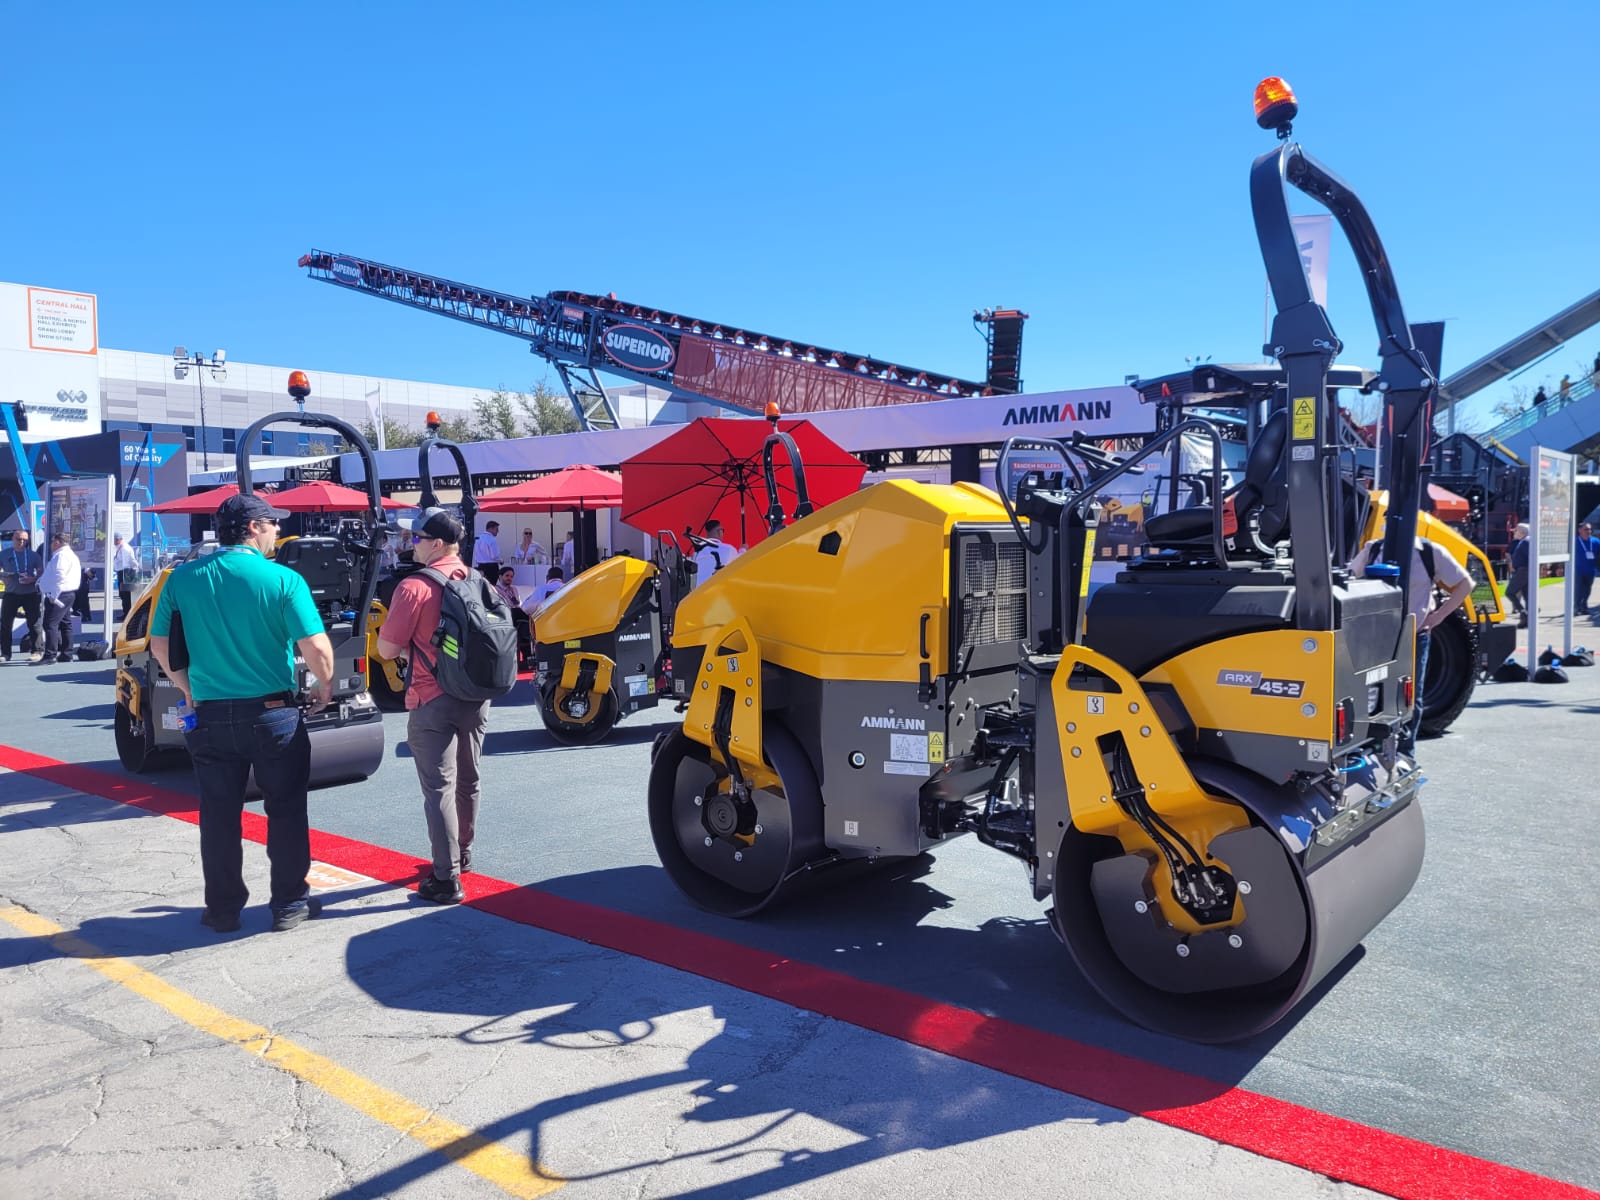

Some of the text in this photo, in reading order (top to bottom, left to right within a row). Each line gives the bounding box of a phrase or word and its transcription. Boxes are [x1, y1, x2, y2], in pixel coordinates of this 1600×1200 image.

[333, 262, 361, 279] SUPERIOR
[36, 299, 68, 308] CENTRAL
[606, 332, 671, 363] SUPERIOR
[1002, 400, 1111, 426] AMMANN
[124, 445, 134, 453] 60
[618, 633, 651, 642] AMMANN
[1225, 673, 1301, 695] ARX 45-2
[860, 716, 926, 731] AMMANN
